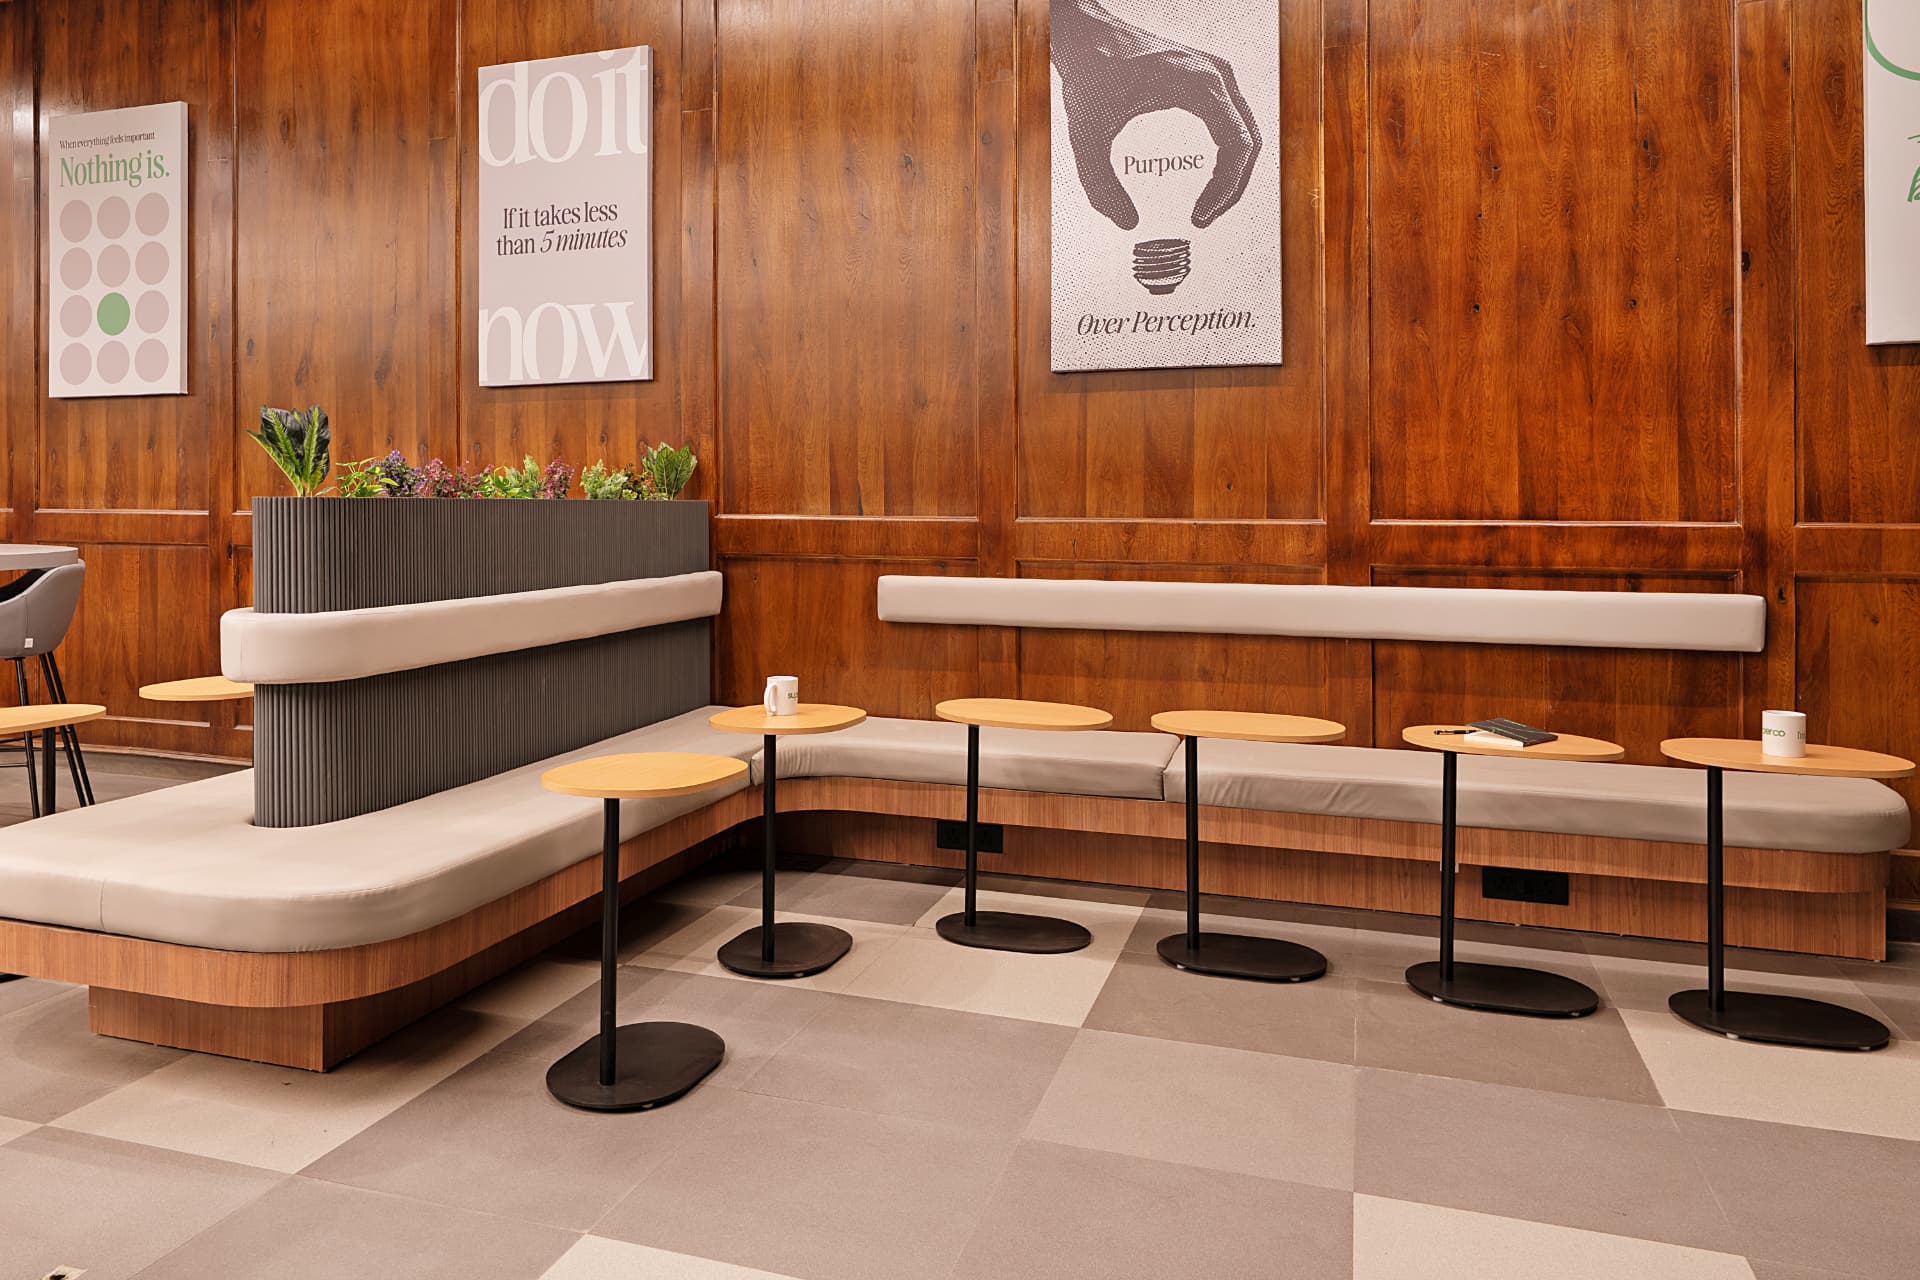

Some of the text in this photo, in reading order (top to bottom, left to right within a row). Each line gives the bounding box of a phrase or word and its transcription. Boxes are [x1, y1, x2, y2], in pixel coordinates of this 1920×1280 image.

[479, 46, 648, 168] do it
[60, 131, 155, 150] When everything feels important
[60, 149, 170, 188] Nothing is.
[1124, 153, 1204, 176] Purpose
[504, 201, 618, 229] If it takes less
[496, 228, 628, 256] than 5 minutes
[1077, 308, 1256, 336] Over Perception.
[479, 302, 648, 383] now
